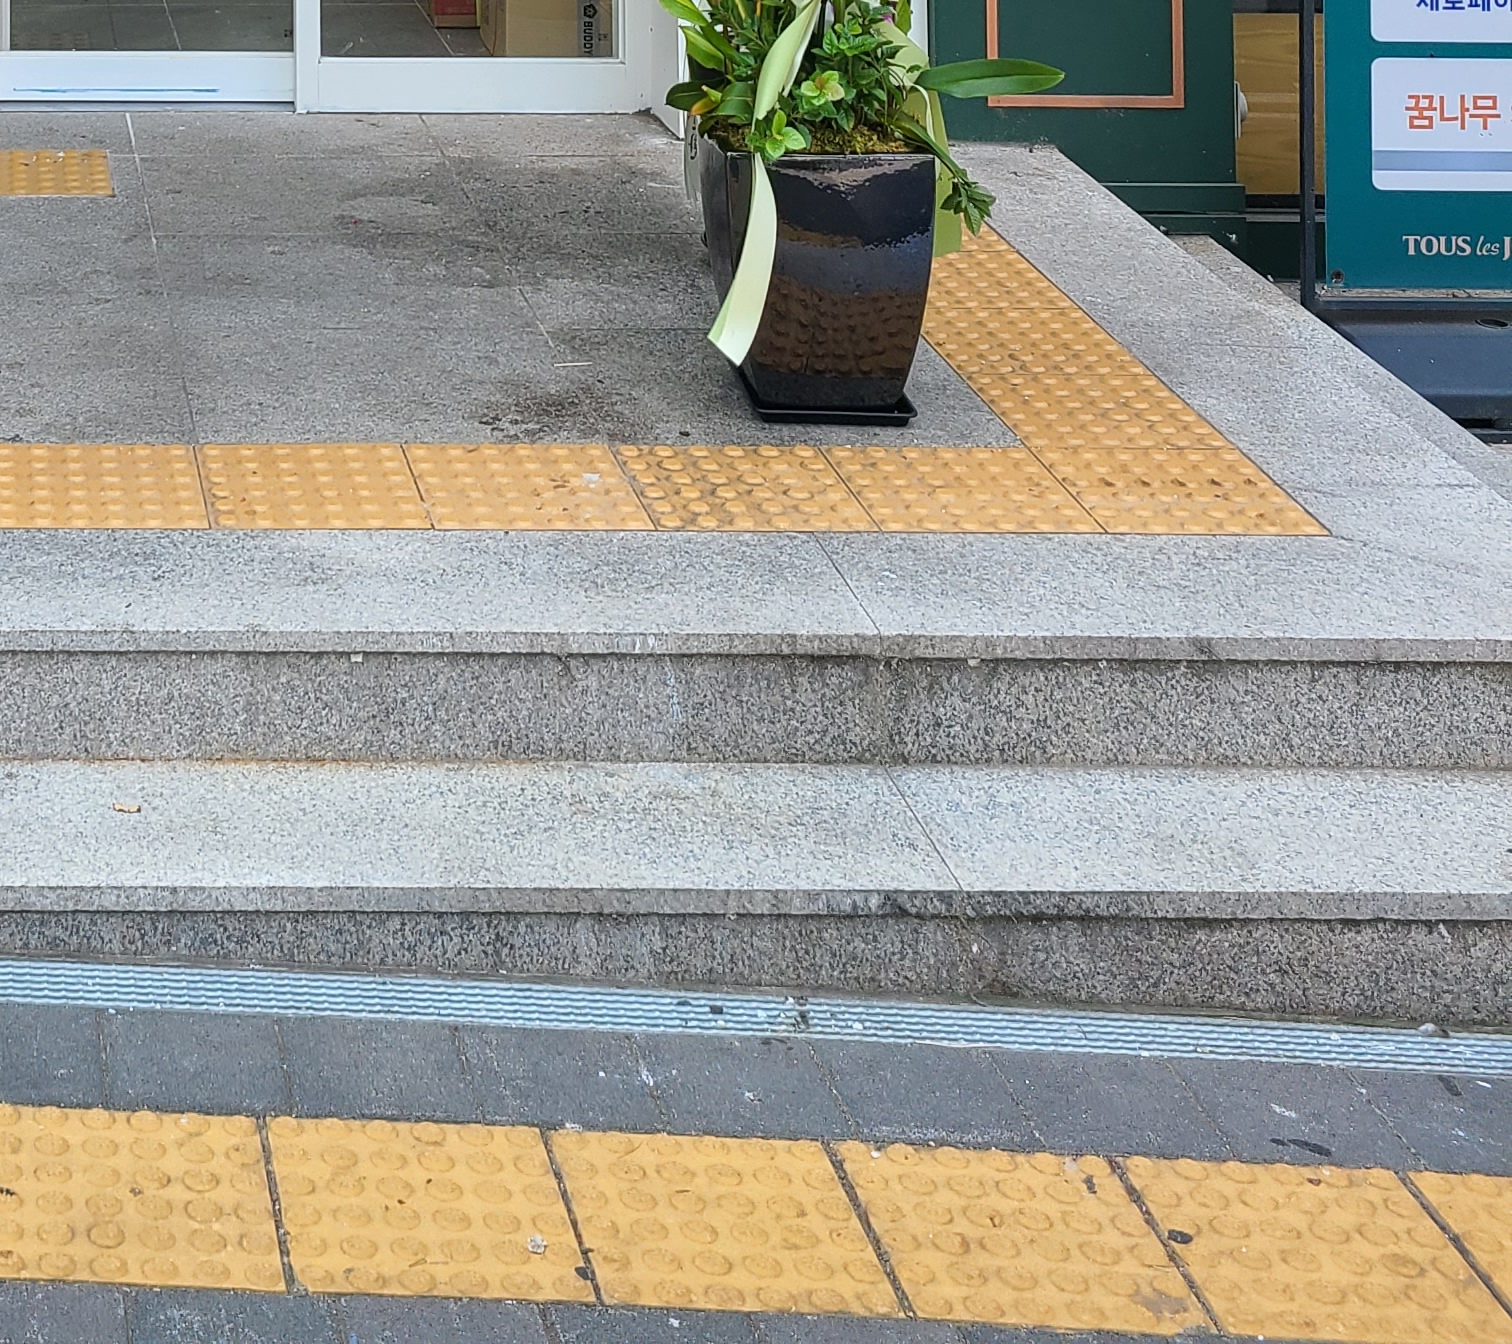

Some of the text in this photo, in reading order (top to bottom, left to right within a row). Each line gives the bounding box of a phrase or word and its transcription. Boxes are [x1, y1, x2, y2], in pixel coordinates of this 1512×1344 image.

[1404, 93, 1501, 132] 꿈나무
[1402, 234, 1472, 258] TOUS
[1474, 233, 1500, 258] les
